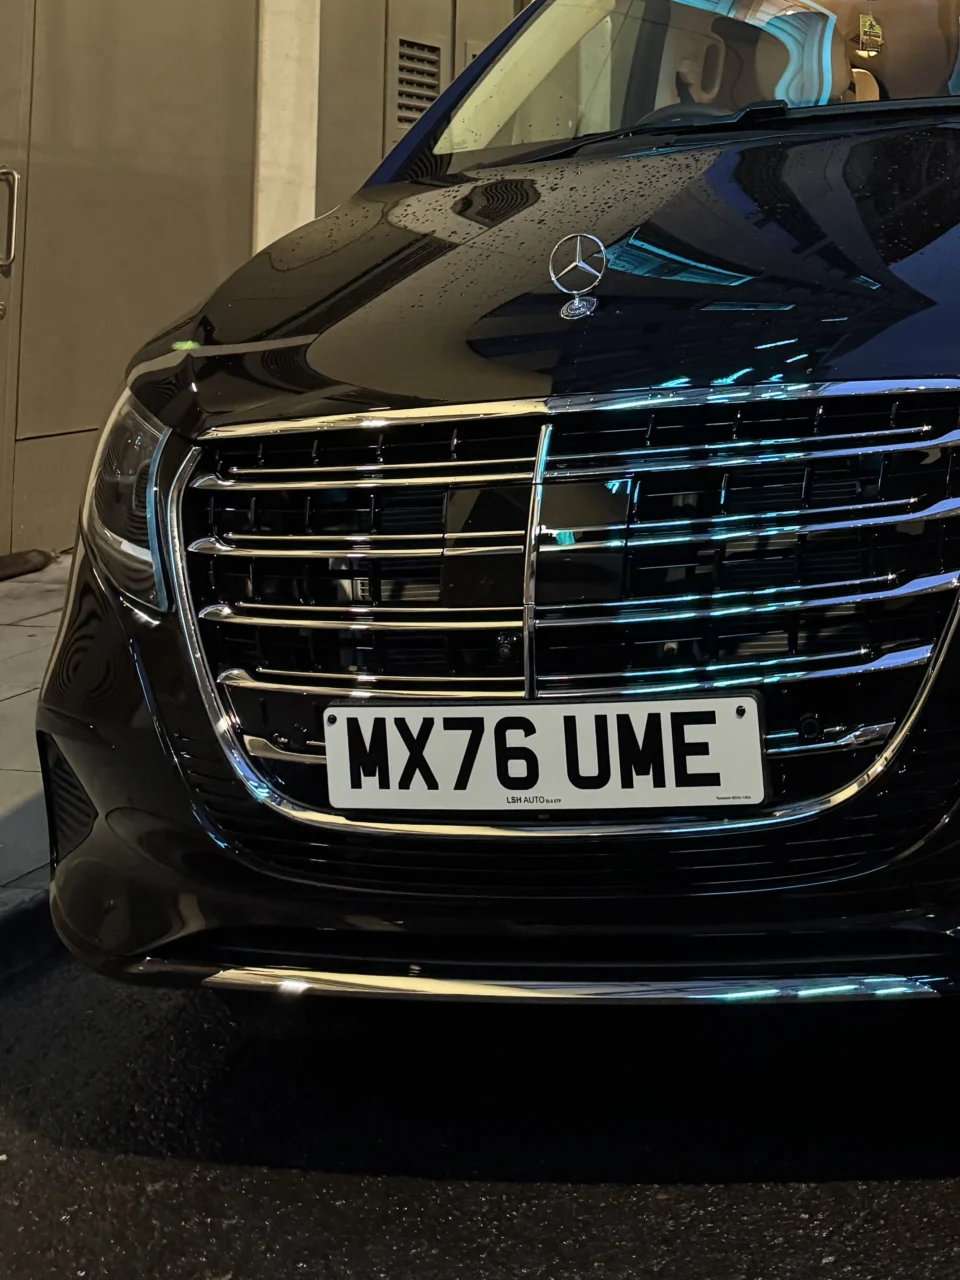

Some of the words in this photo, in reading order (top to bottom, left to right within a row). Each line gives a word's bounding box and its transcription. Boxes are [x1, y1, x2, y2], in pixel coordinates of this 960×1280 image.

[346, 716, 540, 791] MX76
[564, 710, 722, 790] UME
[506, 796, 522, 804] LSH
[523, 796, 545, 804] AUTO
